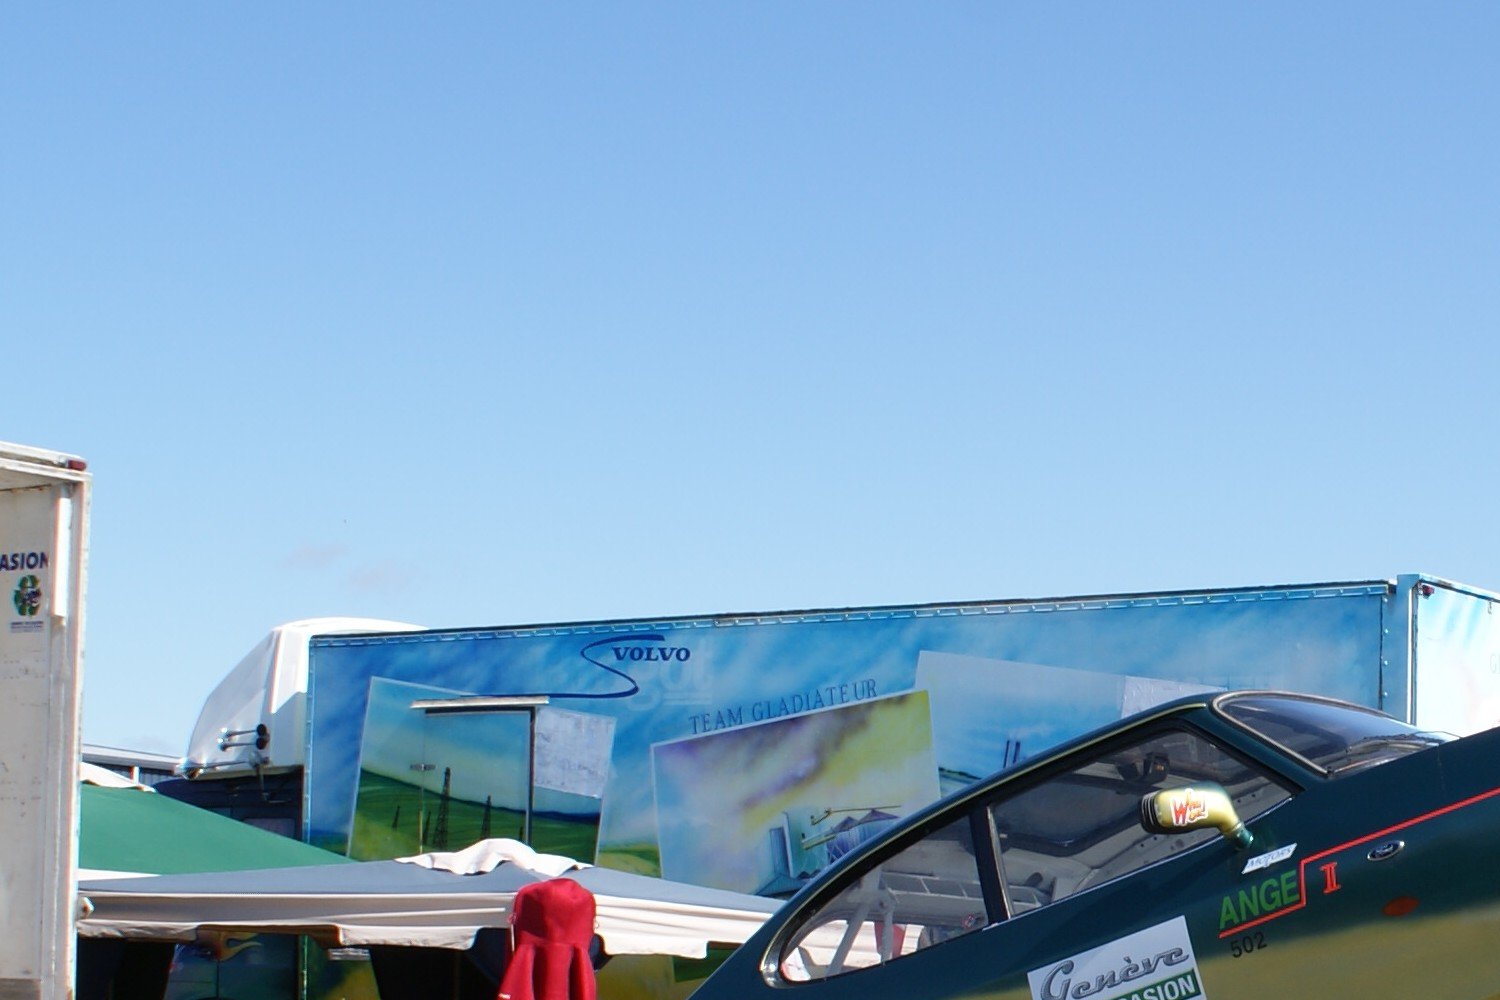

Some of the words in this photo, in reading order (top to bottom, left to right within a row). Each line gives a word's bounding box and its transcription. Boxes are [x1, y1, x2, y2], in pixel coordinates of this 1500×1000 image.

[612, 646, 691, 663] VOLVO
[688, 706, 744, 736] TEAM
[751, 678, 879, 720] GLADIATEUR
[1219, 869, 1301, 930] ANGE
[1231, 931, 1268, 959] 502
